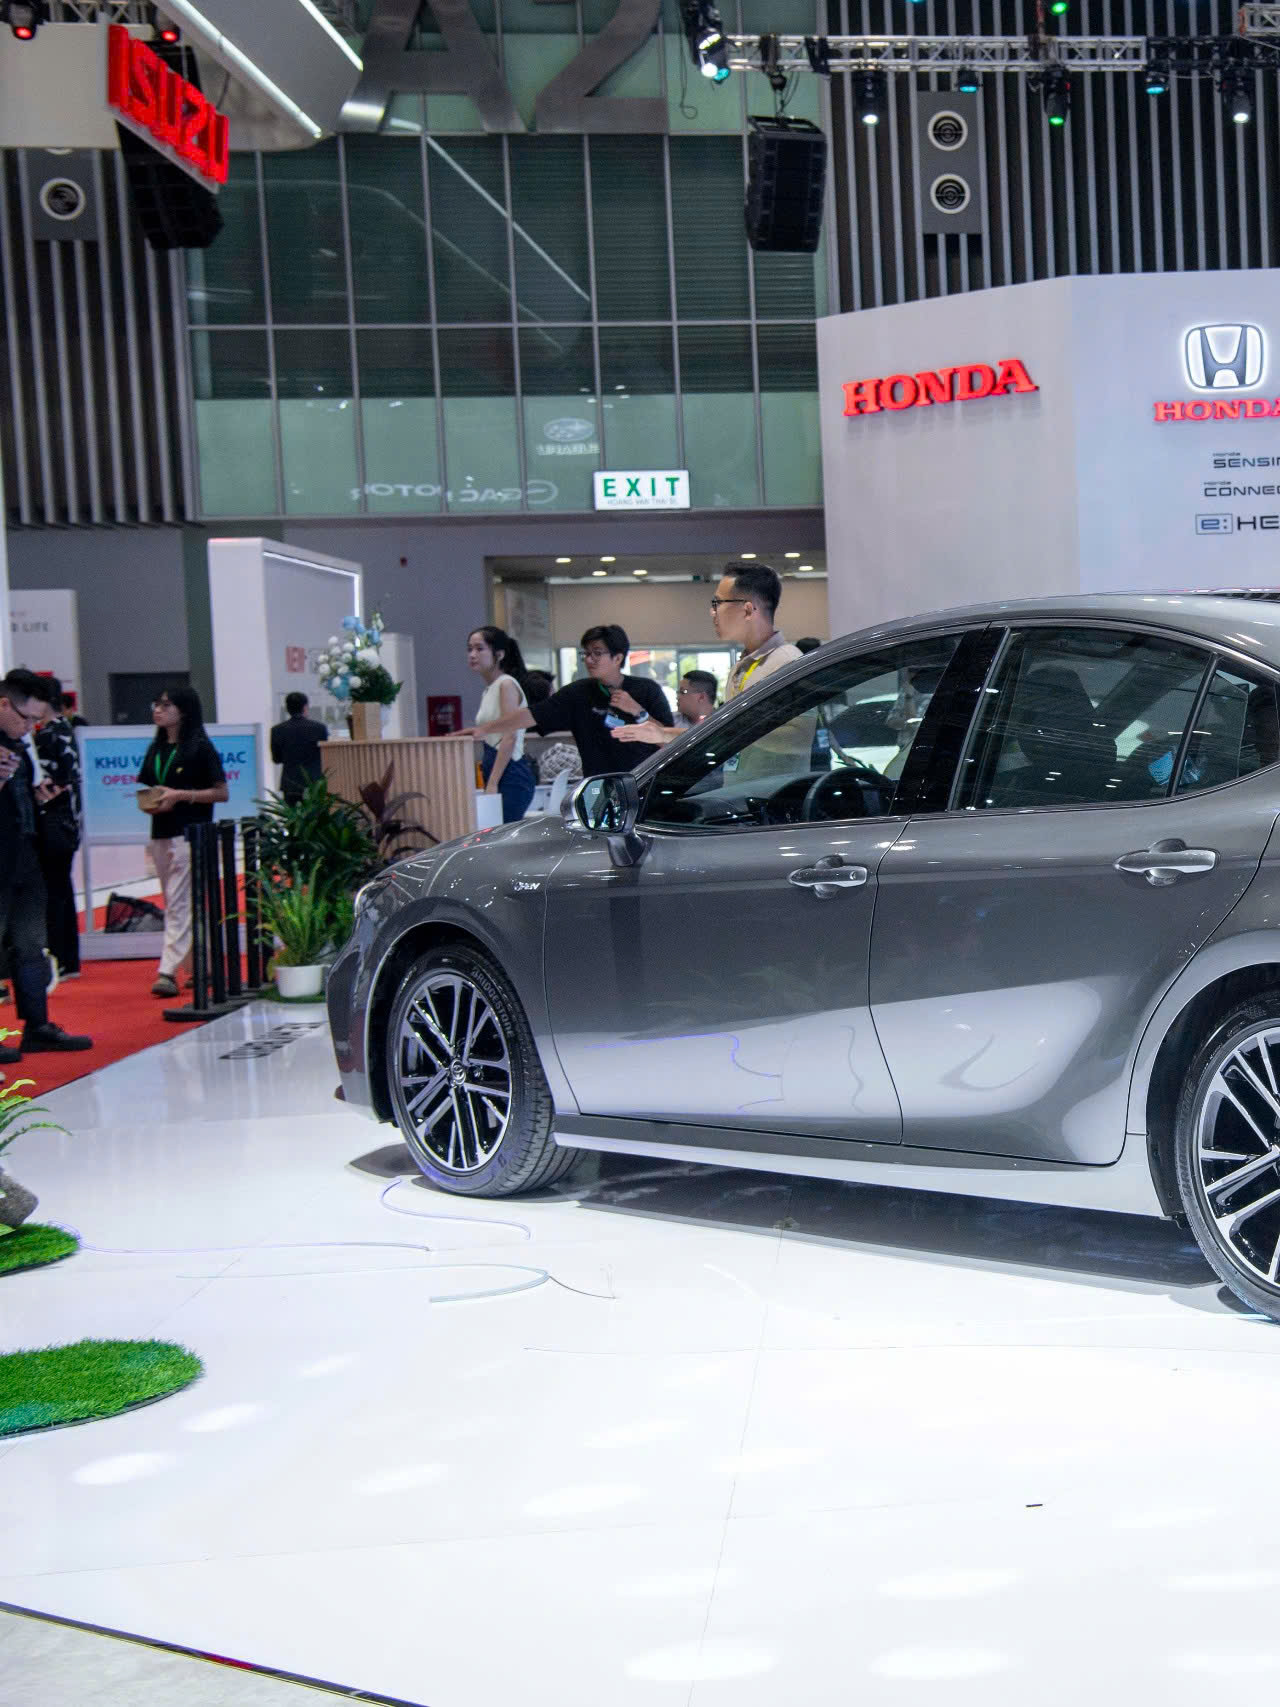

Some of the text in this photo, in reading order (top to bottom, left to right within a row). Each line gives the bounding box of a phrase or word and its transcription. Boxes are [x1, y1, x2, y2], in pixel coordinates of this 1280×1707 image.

[108, 23, 230, 185] ISUZU
[842, 357, 1039, 417] HONDA
[603, 477, 680, 497] EXIT
[94, 756, 128, 769] KHU
